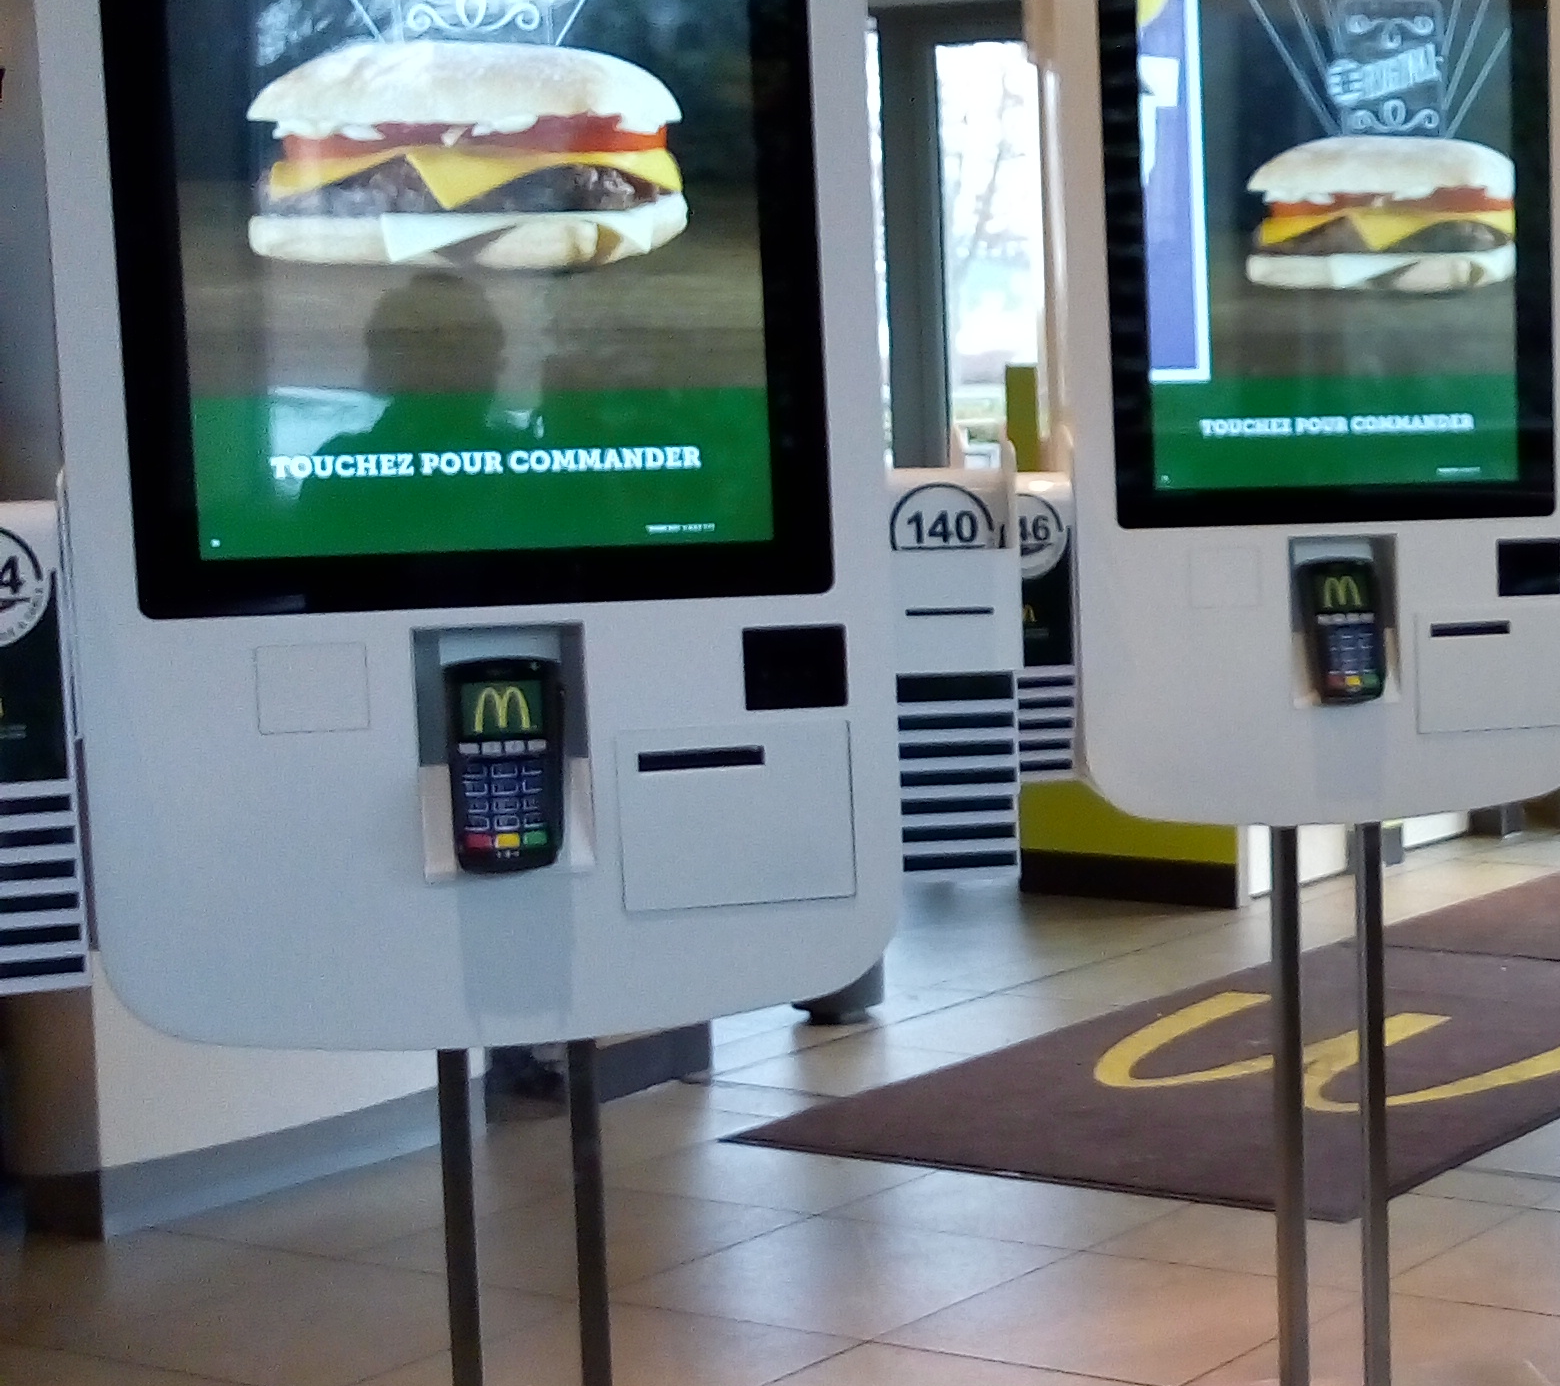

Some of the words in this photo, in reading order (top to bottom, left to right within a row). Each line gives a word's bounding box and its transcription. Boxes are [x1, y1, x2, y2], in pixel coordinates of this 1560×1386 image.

[1201, 417, 1293, 437] TOUCHEZ
[1295, 416, 1348, 435] POUR
[1351, 413, 1474, 434] COMMANDER
[271, 453, 414, 479] TOUCHEZ
[421, 452, 502, 476] POUR
[508, 446, 700, 473] COMMANDER
[907, 509, 978, 544] 140
